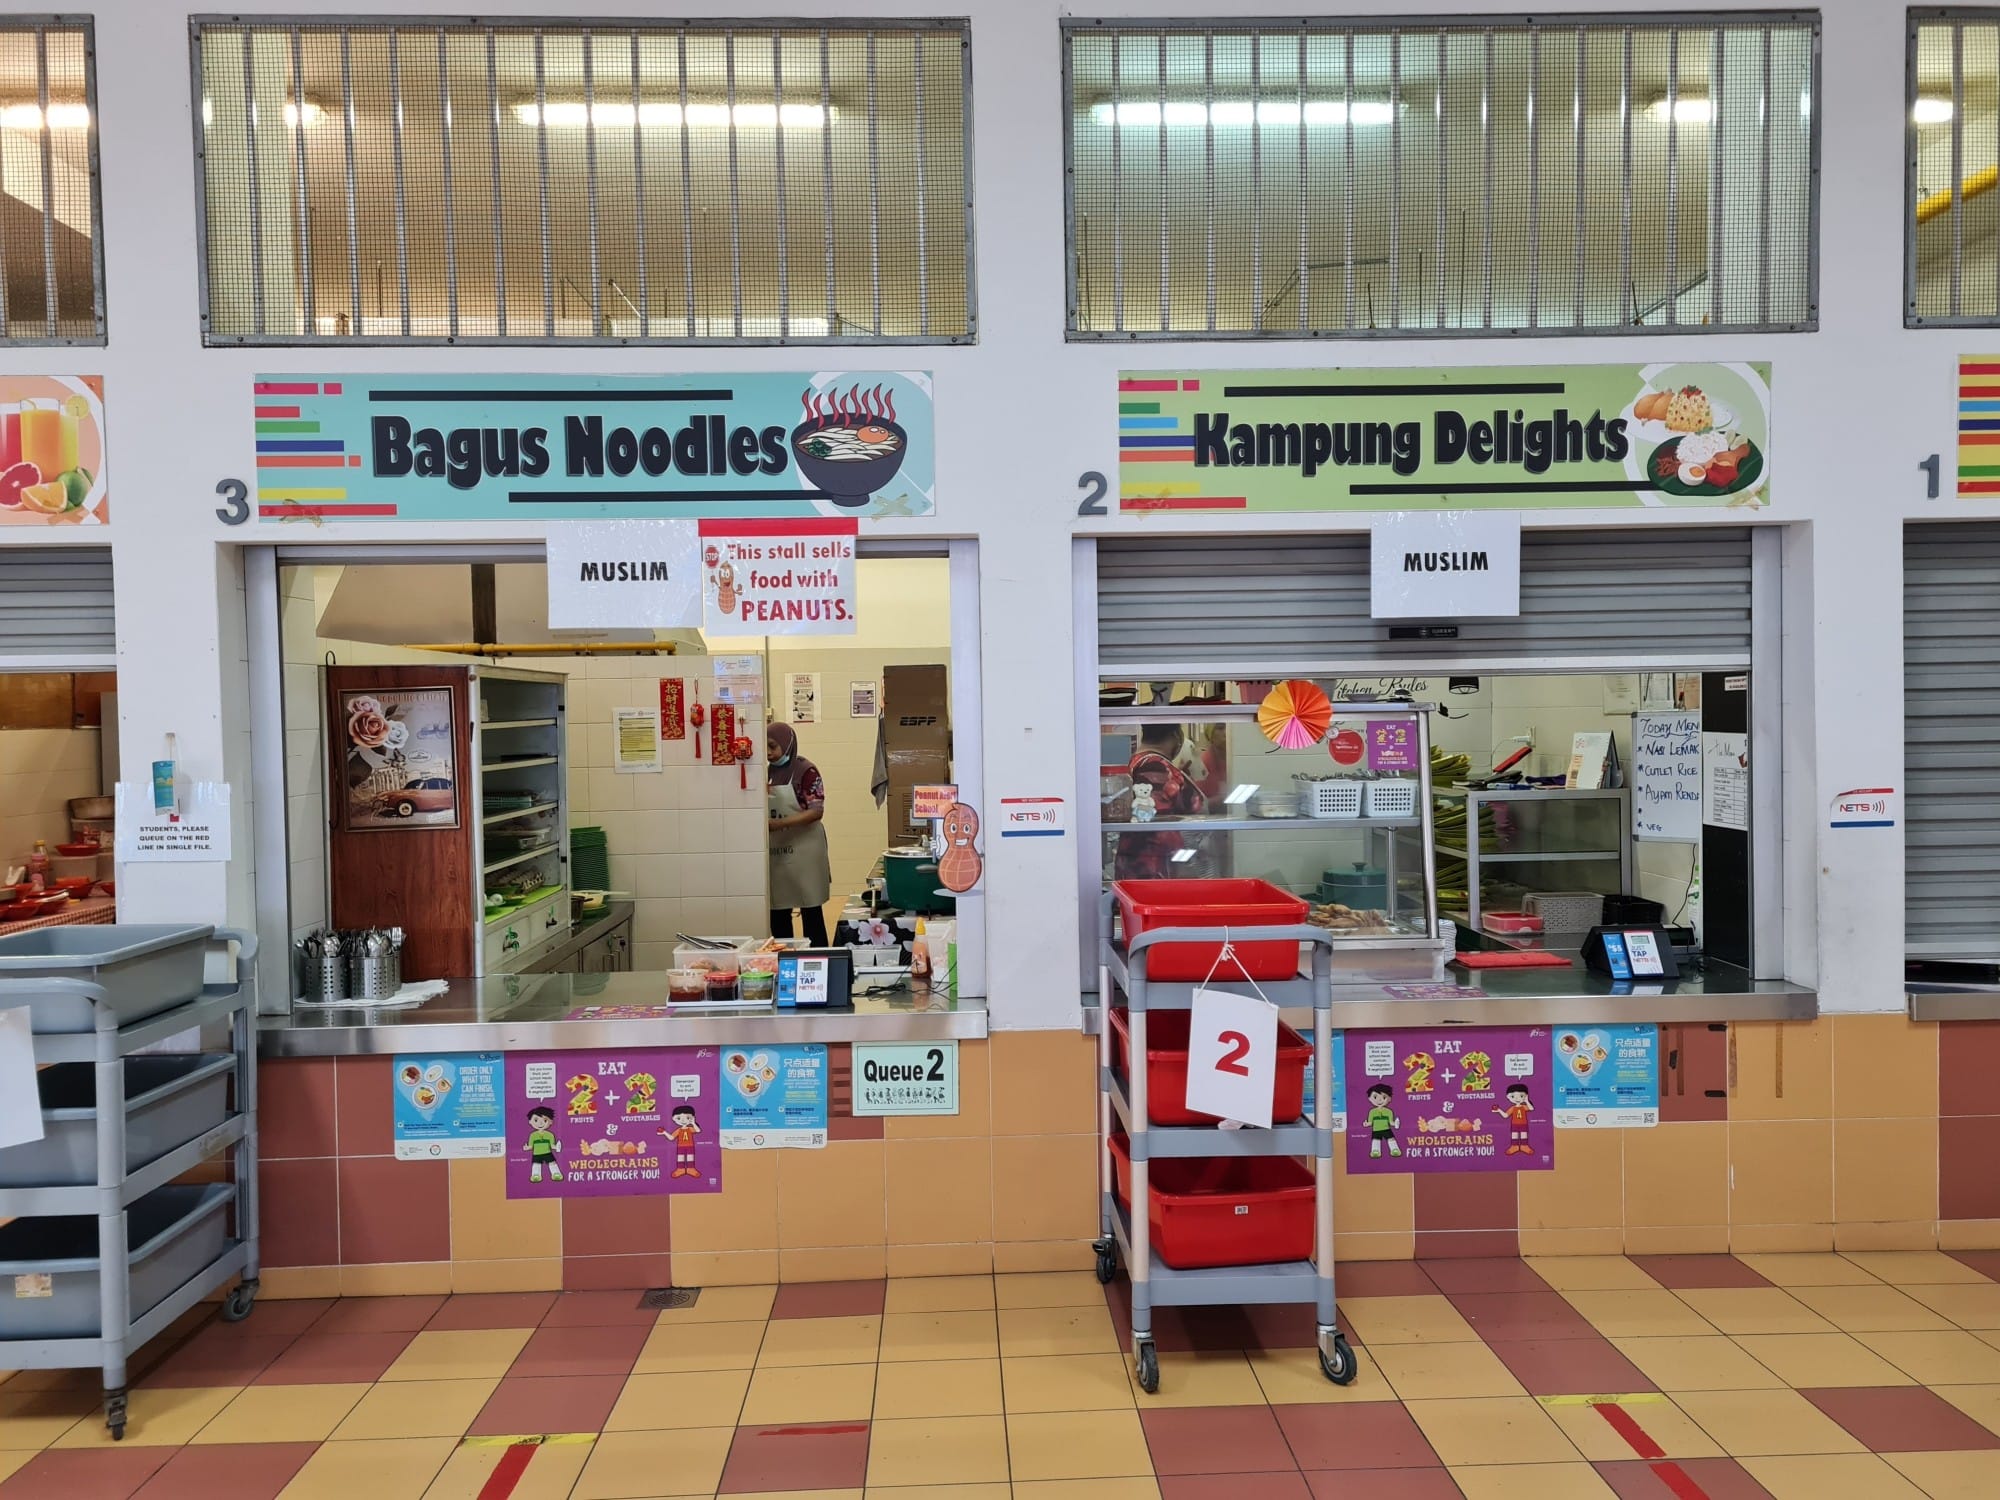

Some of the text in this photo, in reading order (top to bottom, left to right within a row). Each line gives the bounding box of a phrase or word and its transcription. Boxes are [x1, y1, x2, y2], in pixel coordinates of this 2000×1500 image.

[1193, 408, 1629, 477] Kampung Delights
[372, 414, 789, 490] Bagus Noodles
[1918, 454, 1940, 499] 1
[1077, 471, 1108, 516] 2
[215, 478, 250, 526] 3
[705, 552, 719, 561] STOP
[727, 541, 851, 560] This stall sells
[1403, 551, 1489, 572] MUSLIM
[580, 561, 669, 582] MUSLIM
[750, 569, 838, 588] food with
[741, 598, 854, 622] PEANUTS.
[915, 790, 938, 800] Peanut
[915, 803, 938, 813] School
[1840, 803, 1871, 812] NETS
[1010, 812, 1041, 821] NETS
[1215, 1031, 1250, 1077] 2
[1434, 1041, 1462, 1054] EAT
[598, 1062, 627, 1075] EAT
[863, 1048, 945, 1082] Queue 2
[1402, 1052, 1435, 1092] 2
[1459, 1051, 1491, 1092] 2
[480, 1075, 491, 1083] YOU
[565, 1073, 599, 1115] 2
[624, 1072, 656, 1114] 2
[1443, 1101, 1454, 1113] &
[621, 1114, 661, 1122] VEGETABLES
[606, 1123, 618, 1136] &
[1407, 1134, 1493, 1146] WHOLEGRAINS
[1406, 1146, 1495, 1157] FOR A STRONGER YOU!
[569, 1157, 659, 1170] WHOLEGRAINS
[568, 1168, 660, 1182] FOR A STRONGER YOU!
